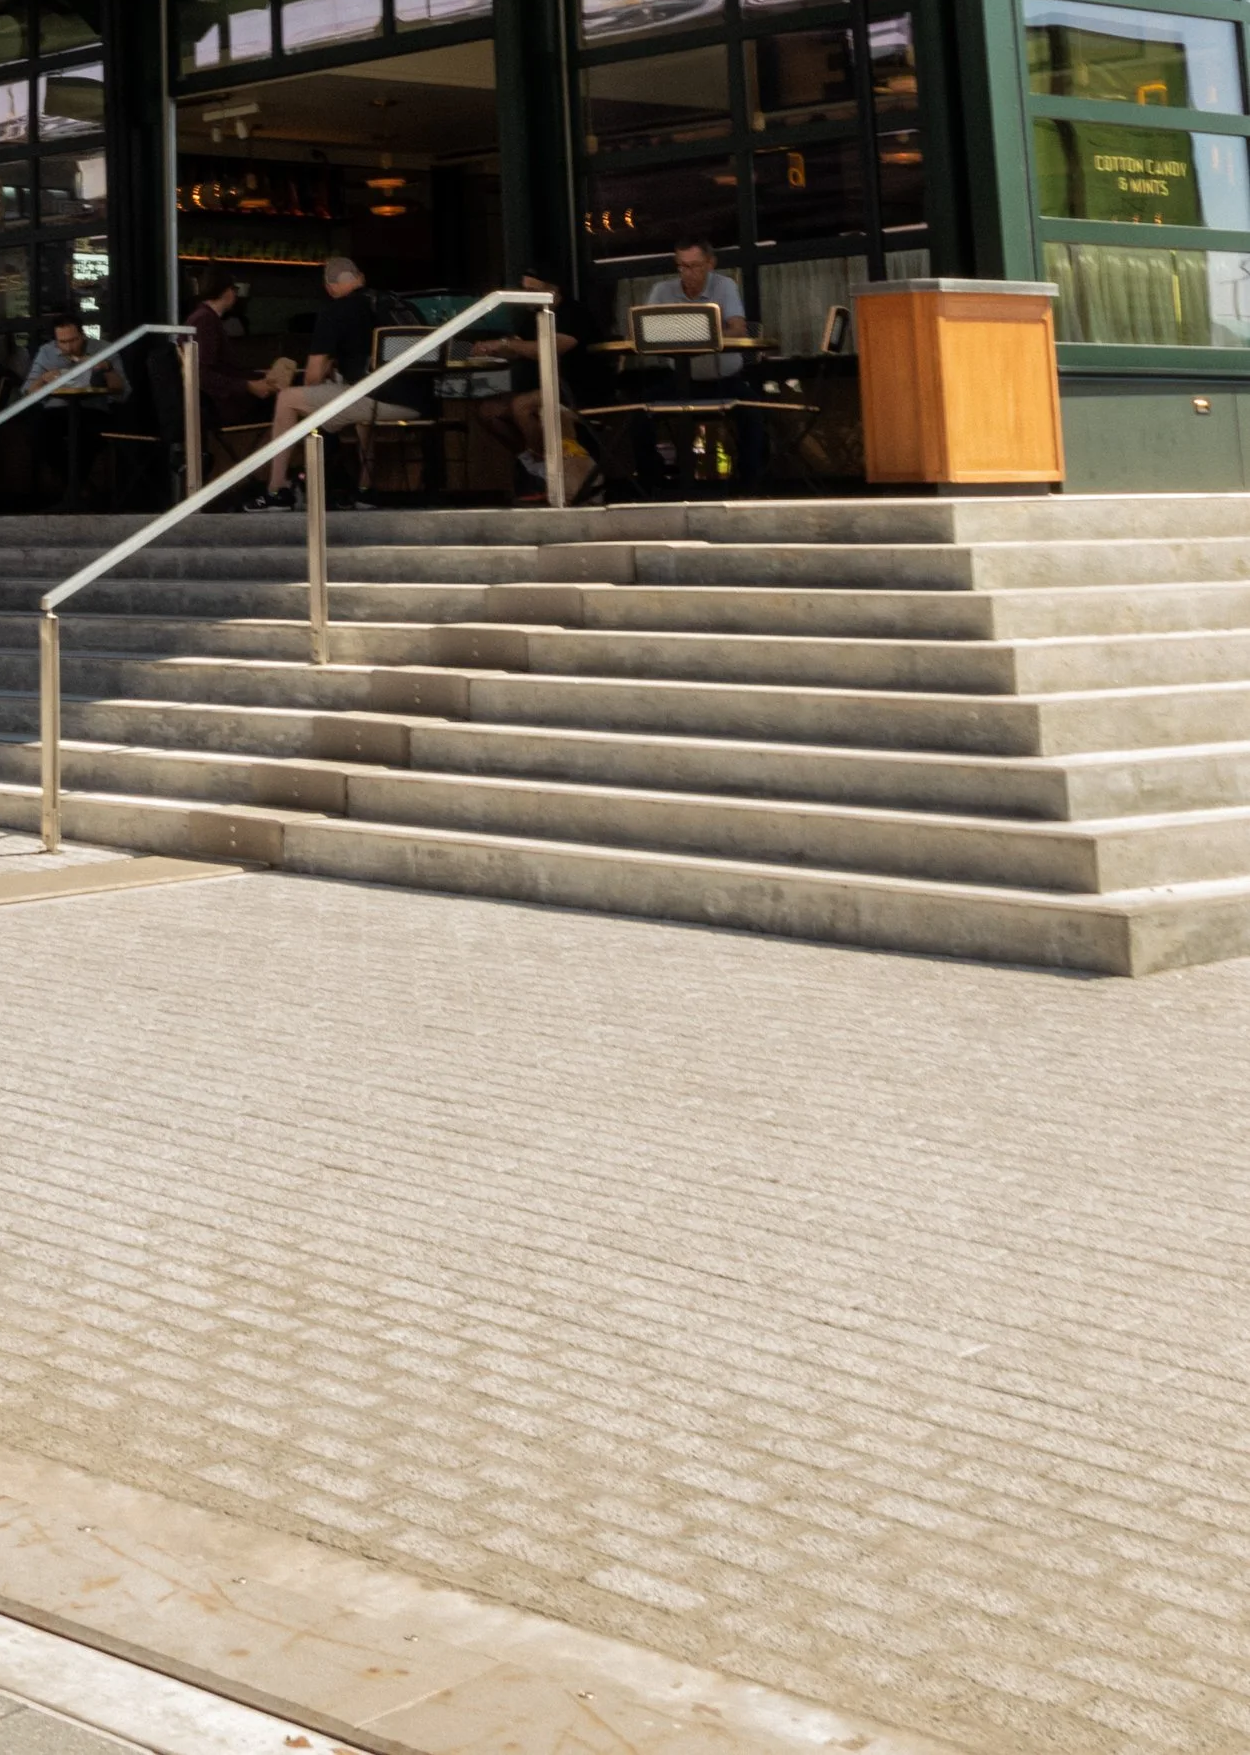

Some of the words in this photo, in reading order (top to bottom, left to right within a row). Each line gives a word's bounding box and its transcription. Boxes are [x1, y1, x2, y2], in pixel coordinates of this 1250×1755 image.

[1093, 154, 1144, 173] COTTON
[1145, 158, 1187, 178] CANDY
[1129, 178, 1169, 197] MINTS
